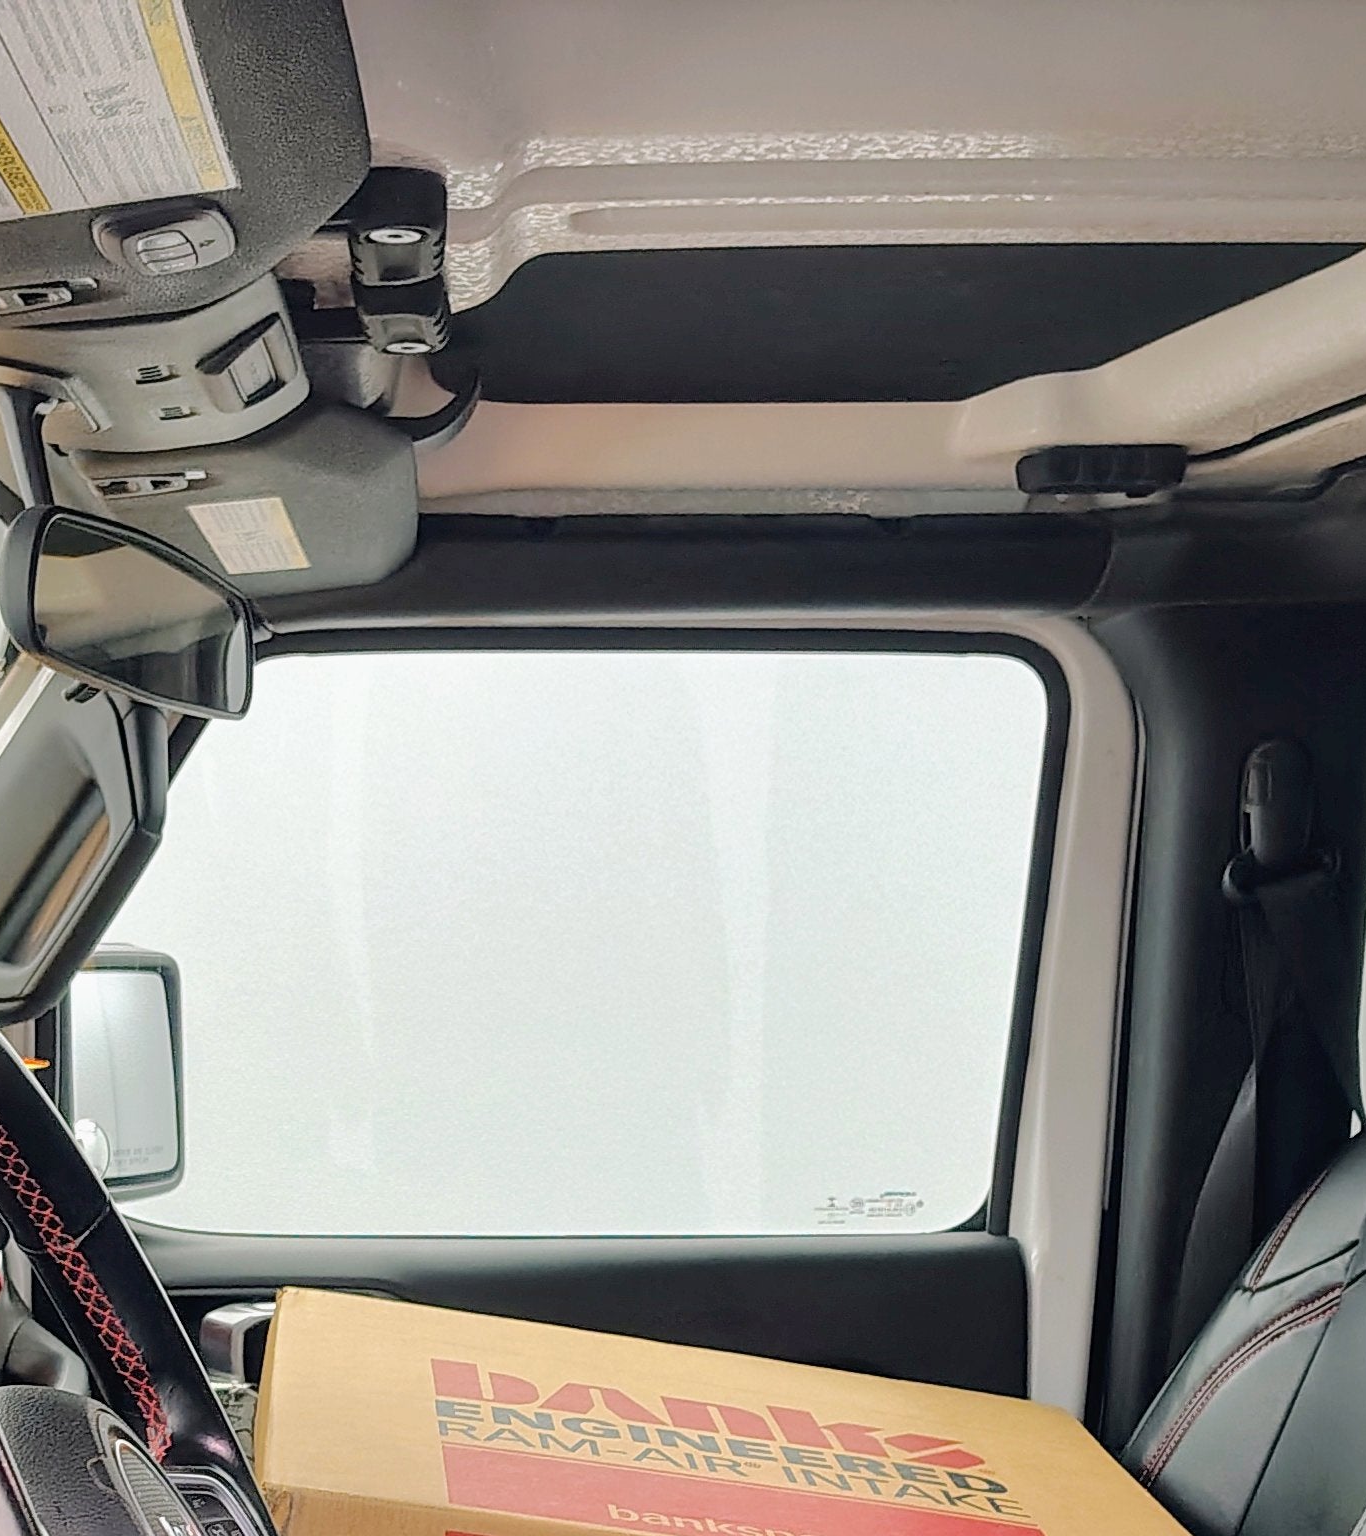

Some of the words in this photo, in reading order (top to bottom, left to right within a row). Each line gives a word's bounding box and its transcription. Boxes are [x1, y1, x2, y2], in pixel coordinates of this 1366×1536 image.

[435, 1399, 1009, 1494] ENGINEERED
[437, 1419, 749, 1478] RAM-AIR
[781, 1465, 1032, 1519] INTAKE
